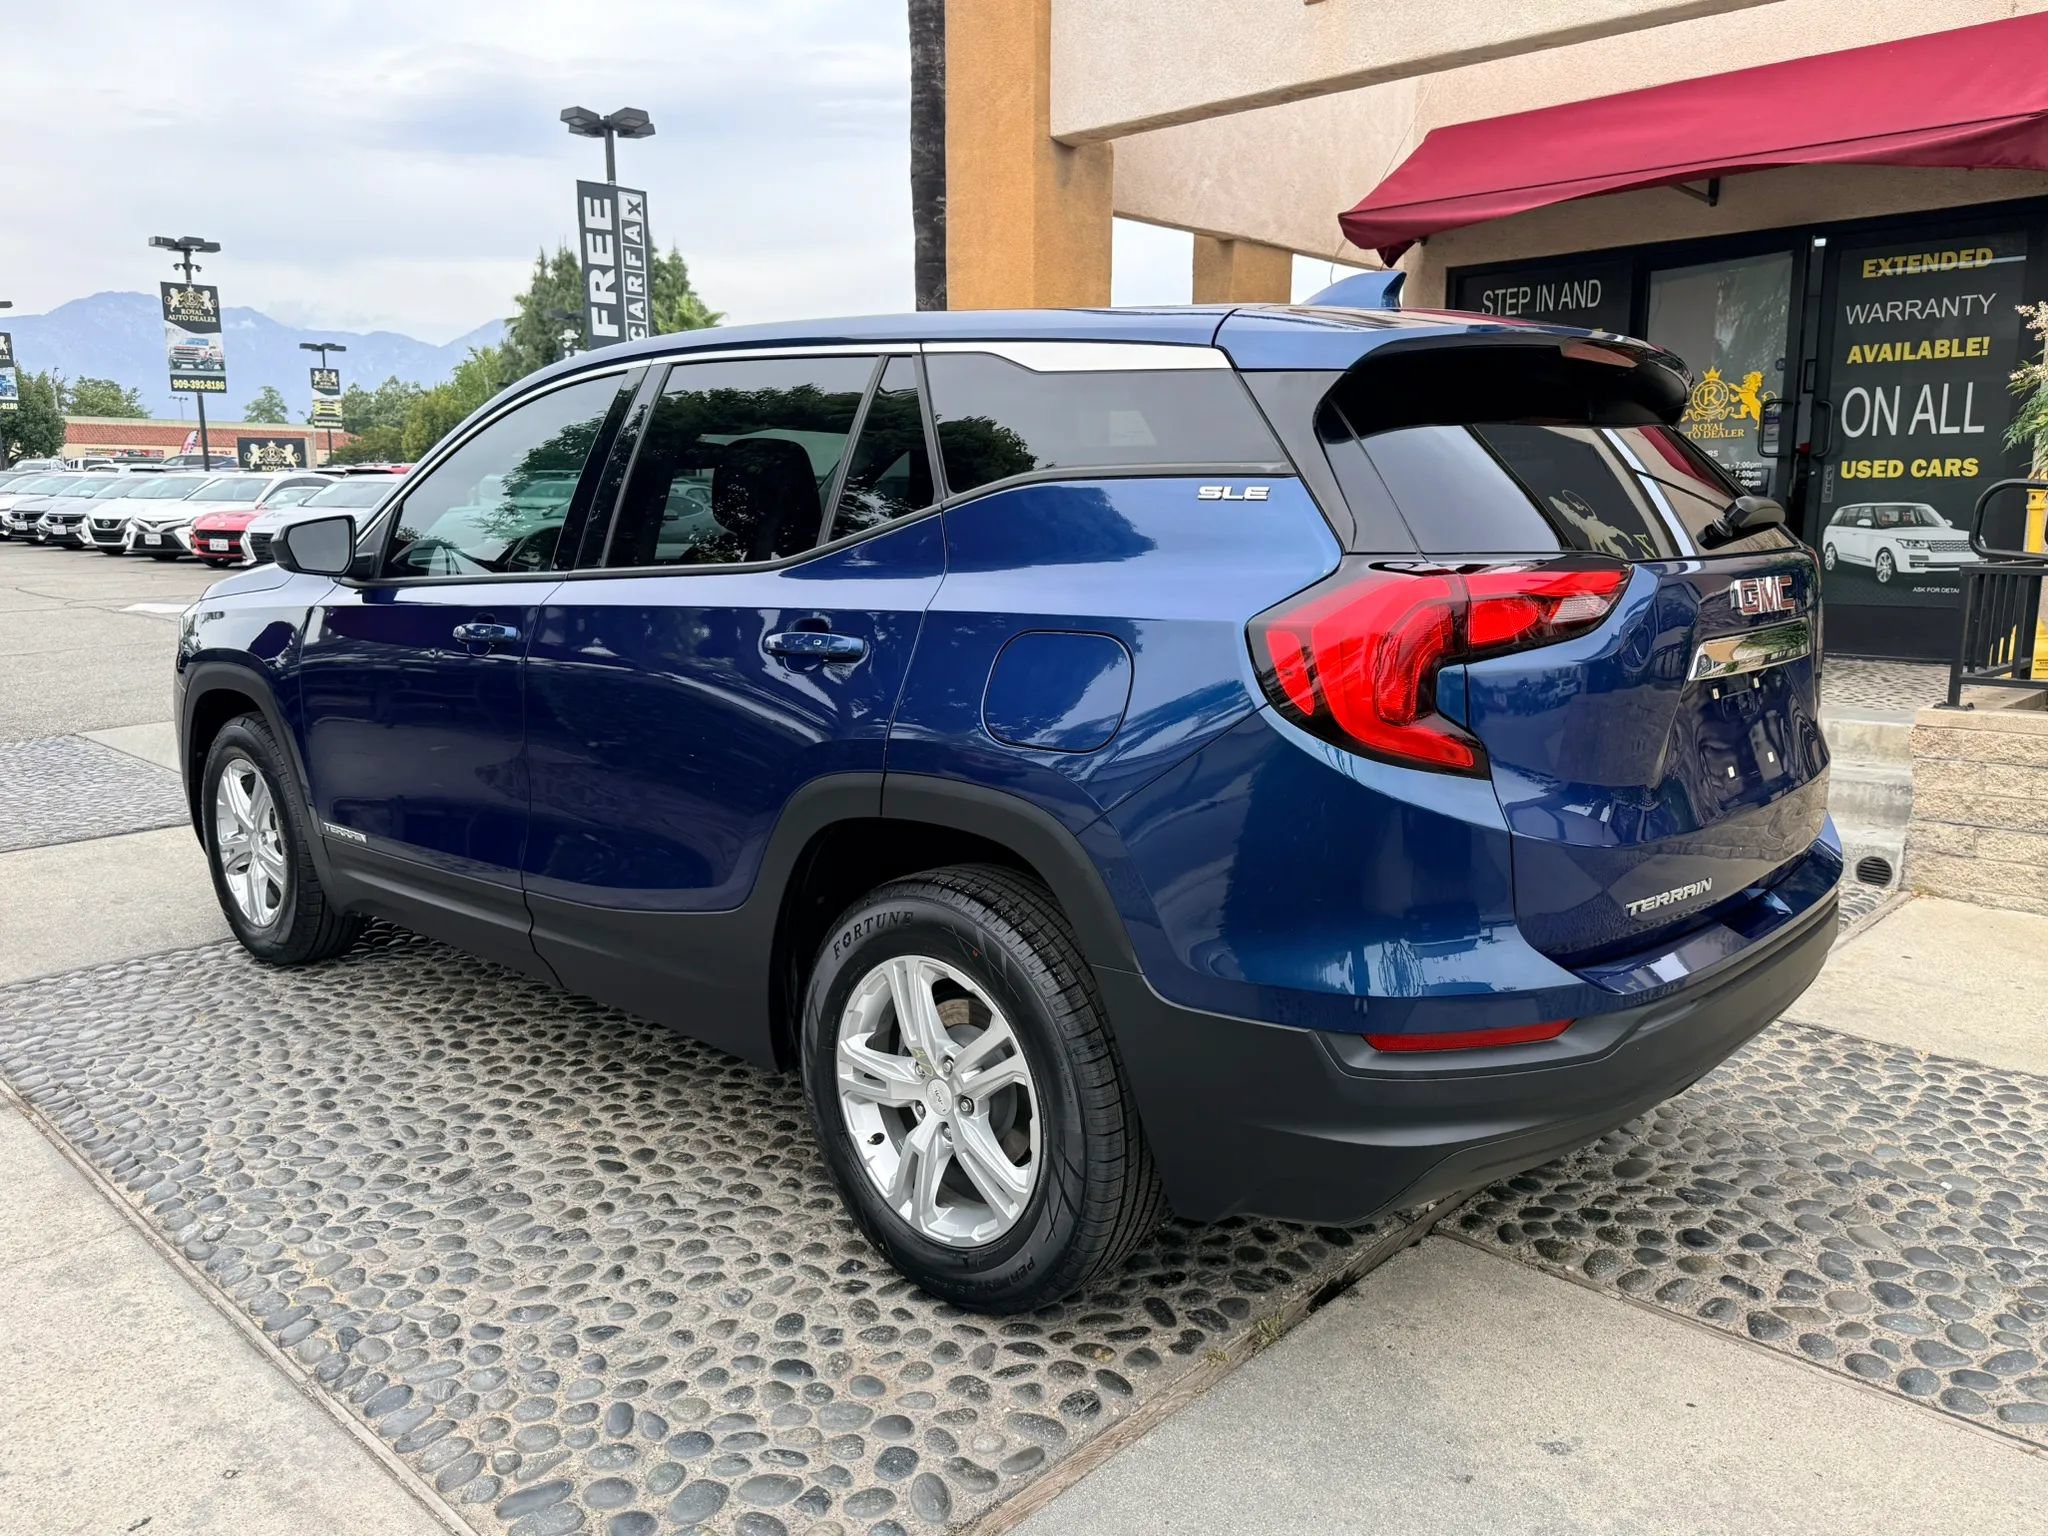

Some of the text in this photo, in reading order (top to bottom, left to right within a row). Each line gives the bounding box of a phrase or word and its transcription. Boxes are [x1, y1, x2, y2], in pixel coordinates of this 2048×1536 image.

[583, 196, 619, 338] FREE
[623, 199, 646, 341] CARFAX
[1862, 247, 1993, 279] EXTENDED
[181, 308, 204, 316] ROYAL
[1481, 279, 1602, 316] STEP IN AND
[1846, 292, 1997, 325] WARRANTY
[189, 315, 217, 323] DEALER
[1846, 336, 1991, 365] AVAILABLE!
[1841, 385, 1901, 438] ON
[1907, 381, 1985, 435] ALL
[1692, 422, 1725, 432] ROYAL
[1703, 428, 1745, 439] DEALER
[1840, 457, 1980, 479] USED CARS
[1197, 485, 1270, 501] SLE
[1730, 575, 1795, 615] GMC
[1625, 877, 1712, 917] TERRAIN
[832, 910, 914, 961] FORTUNE
